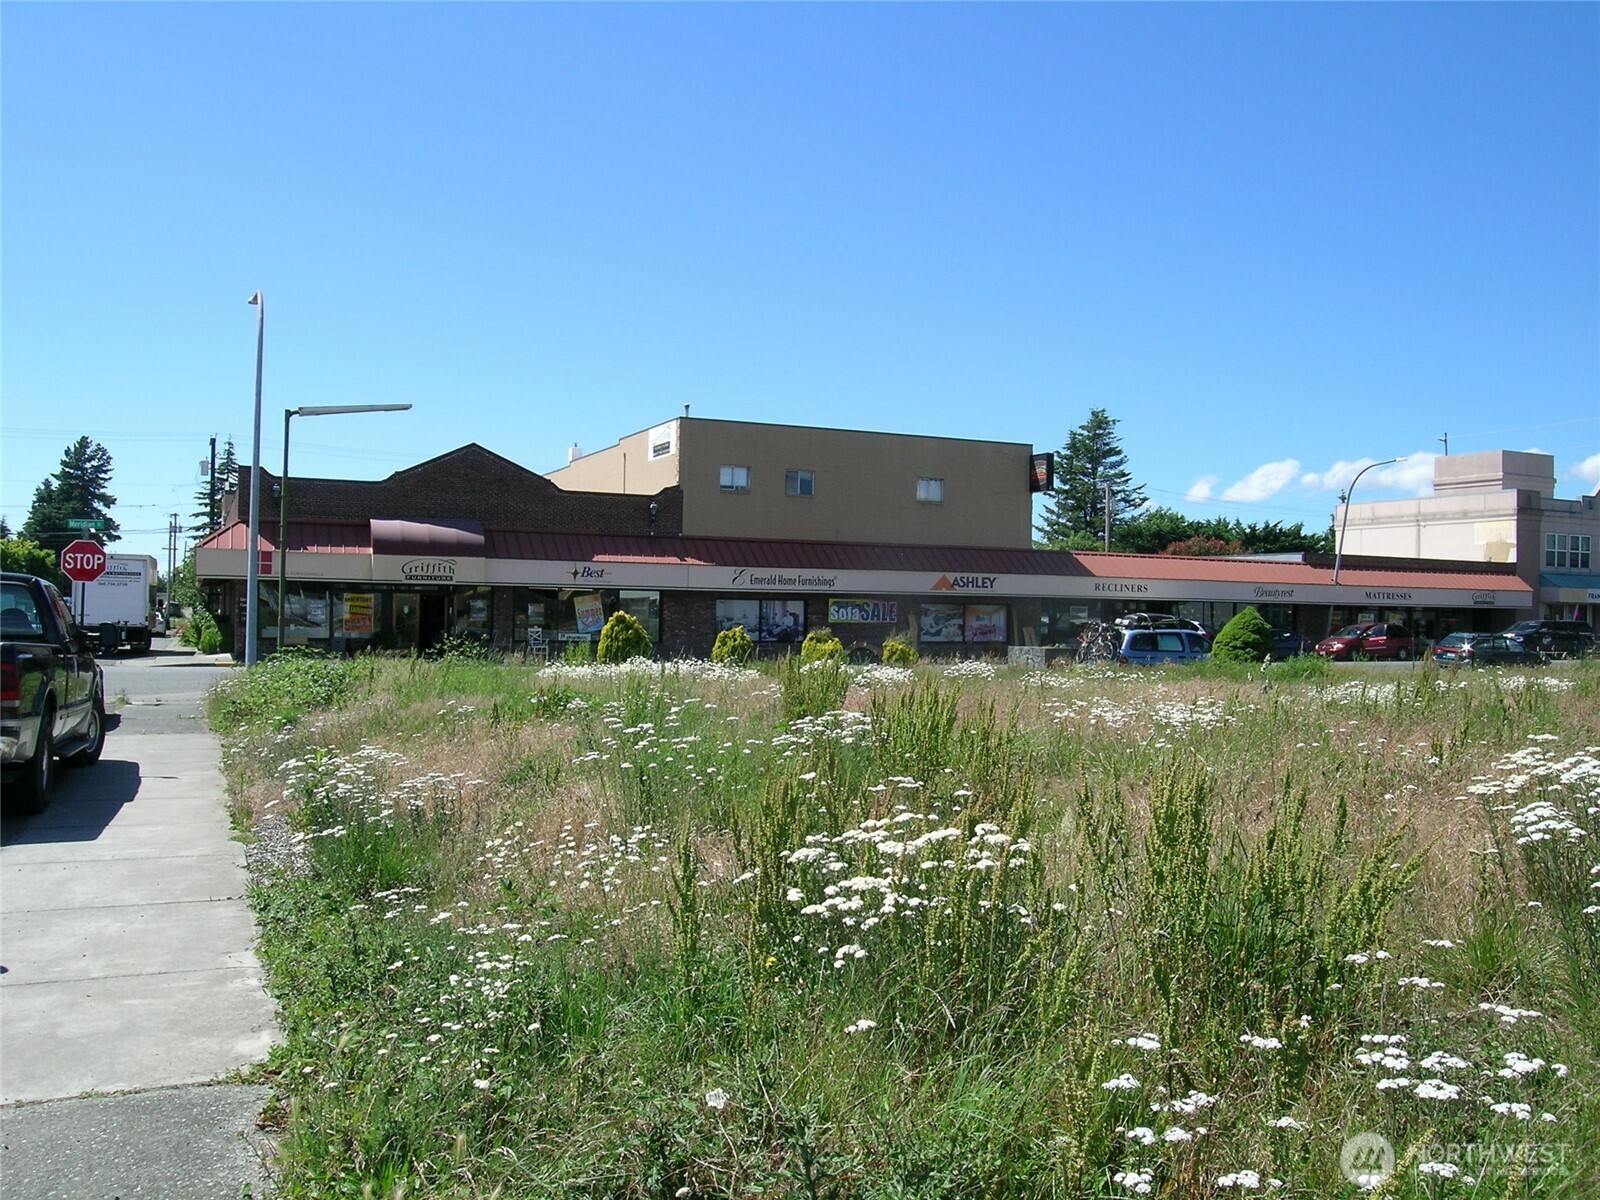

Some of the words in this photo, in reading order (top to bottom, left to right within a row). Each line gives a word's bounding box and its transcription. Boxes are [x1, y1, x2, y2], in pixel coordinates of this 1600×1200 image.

[69, 520, 95, 528] Meridian
[64, 553, 104, 570] STOP
[401, 558, 457, 574] Griffith
[581, 566, 604, 578] Best
[750, 574, 777, 586] Emerald
[778, 574, 797, 586] Home
[798, 575, 836, 588] Furnishings
[951, 576, 997, 589] ASHLEY
[1094, 583, 1149, 593] RECLINERS
[1254, 586, 1294, 599] Beautyrest
[1365, 591, 1412, 600] MATTRESSES
[831, 605, 860, 620] Sofa
[860, 601, 898, 622] SALE
